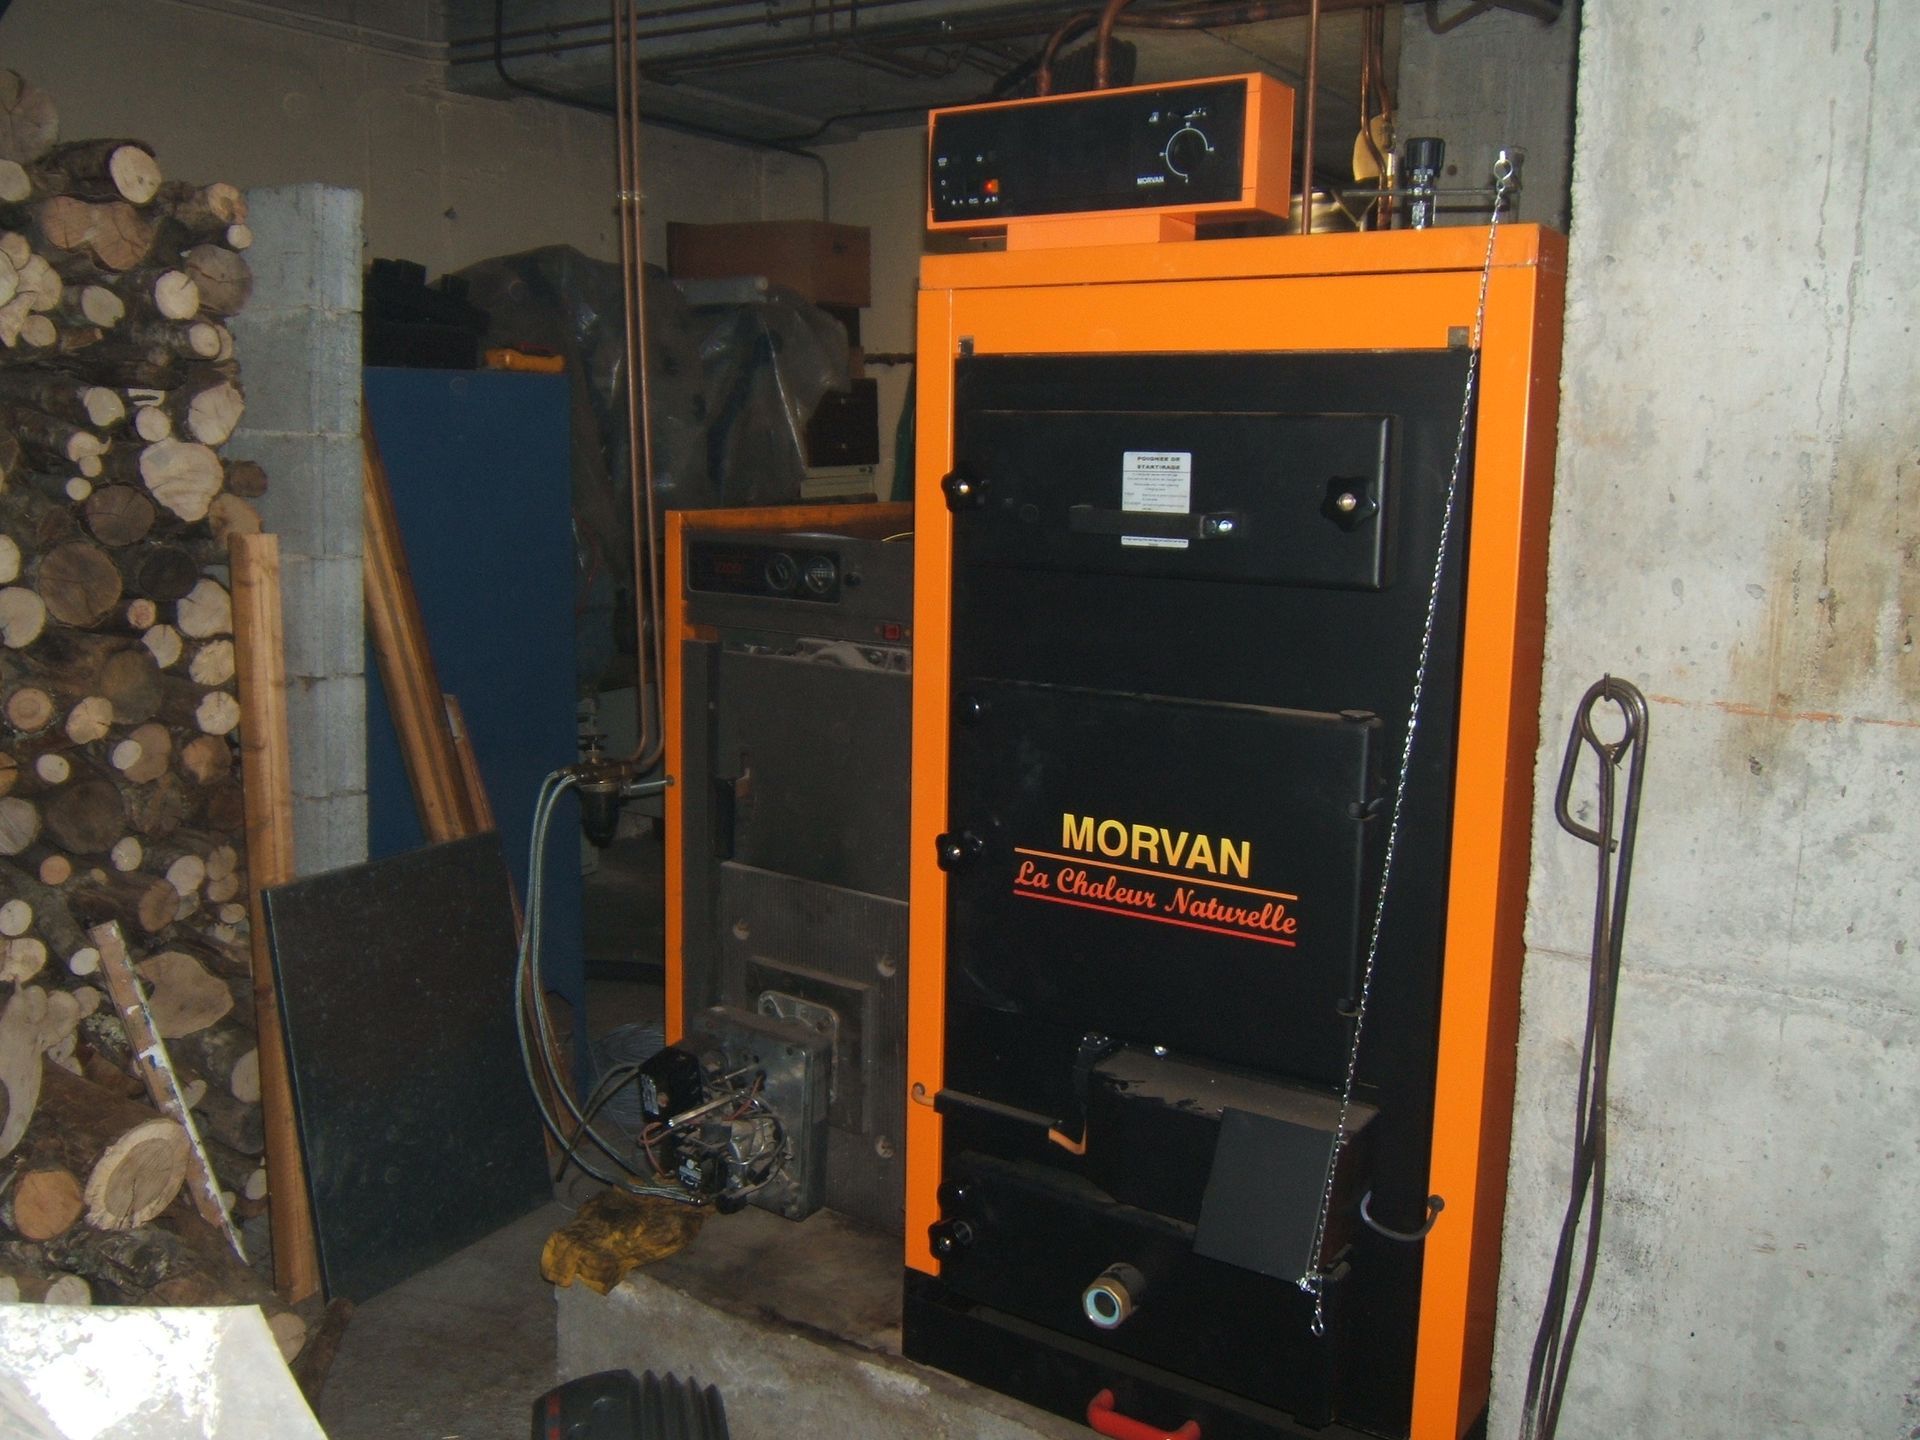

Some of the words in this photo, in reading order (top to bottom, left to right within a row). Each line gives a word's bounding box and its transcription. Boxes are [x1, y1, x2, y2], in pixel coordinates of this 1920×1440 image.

[1136, 176, 1165, 185] MORVAN
[1061, 812, 1252, 879] MORVAN
[1014, 860, 1050, 890] La
[1056, 867, 1157, 909] Chaleur
[1164, 887, 1298, 934] Naturelle
